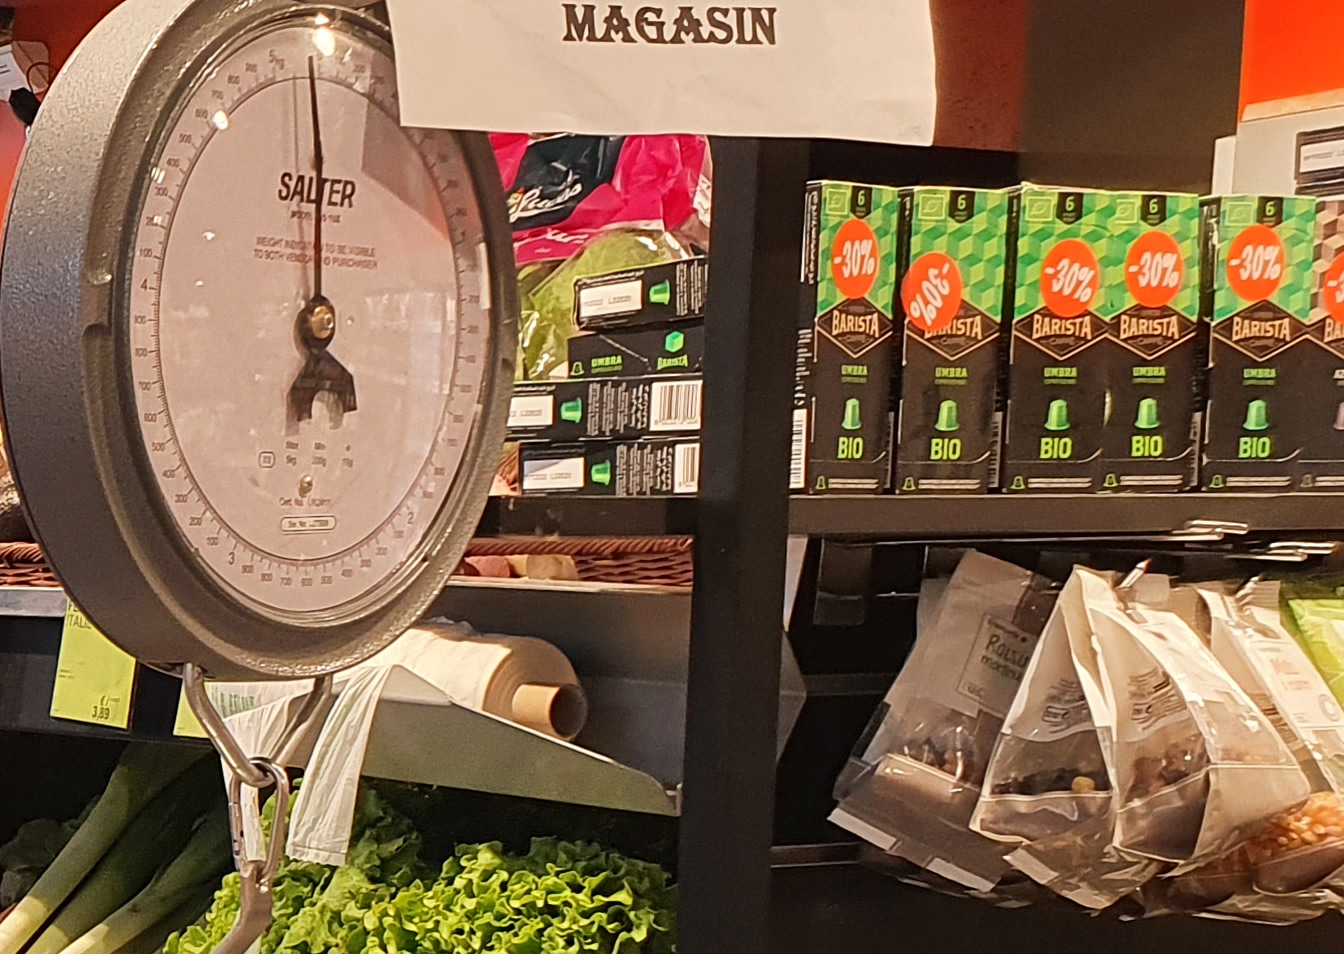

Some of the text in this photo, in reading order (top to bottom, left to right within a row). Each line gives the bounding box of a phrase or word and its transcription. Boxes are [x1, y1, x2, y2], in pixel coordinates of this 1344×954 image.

[562, 4, 777, 45] MAGASIN
[856, 188, 866, 207] 6
[957, 192, 966, 210] 6
[1065, 194, 1076, 213] 6
[1148, 197, 1159, 214] 6
[1264, 197, 1275, 216] 6
[833, 238, 876, 276] -30%
[1228, 247, 1282, 281] -30%
[1128, 252, 1180, 289] -30%
[140, 279, 148, 292] 4
[1044, 264, 1096, 304] -30%
[831, 310, 881, 339] BARISTA
[1032, 312, 1092, 340] BARISTA
[1120, 310, 1180, 339] BARISTA
[1231, 313, 1291, 341] BARISTA
[591, 355, 622, 367] UMBRA
[657, 354, 688, 370] BARISTA
[837, 436, 864, 459] BIO
[930, 438, 962, 461] BIO
[1039, 436, 1072, 460] BIO
[1131, 434, 1163, 457] BIO
[1238, 436, 1271, 458] BIO
